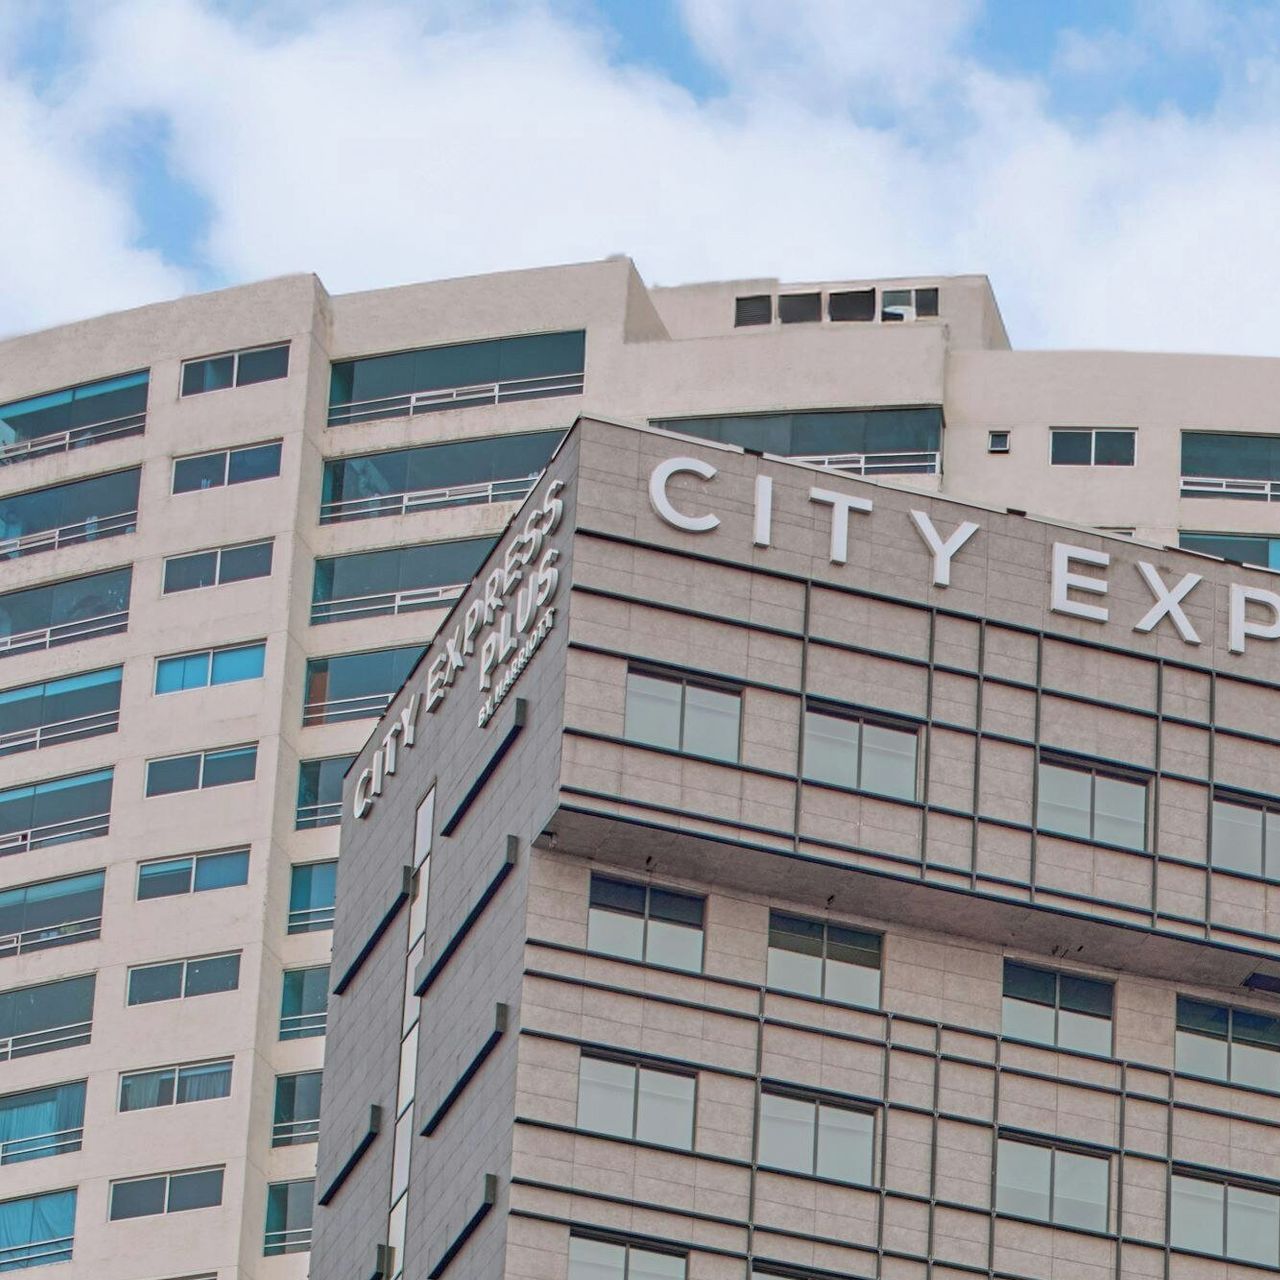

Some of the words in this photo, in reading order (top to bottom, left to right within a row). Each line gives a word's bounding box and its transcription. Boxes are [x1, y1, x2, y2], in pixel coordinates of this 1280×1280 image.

[648, 456, 981, 588] CITY
[352, 692, 421, 820] CITY
[425, 478, 566, 714] EXPRESS
[478, 694, 495, 728] BY
[494, 607, 557, 705] MARRIOTT
[479, 548, 560, 693] PLUS
